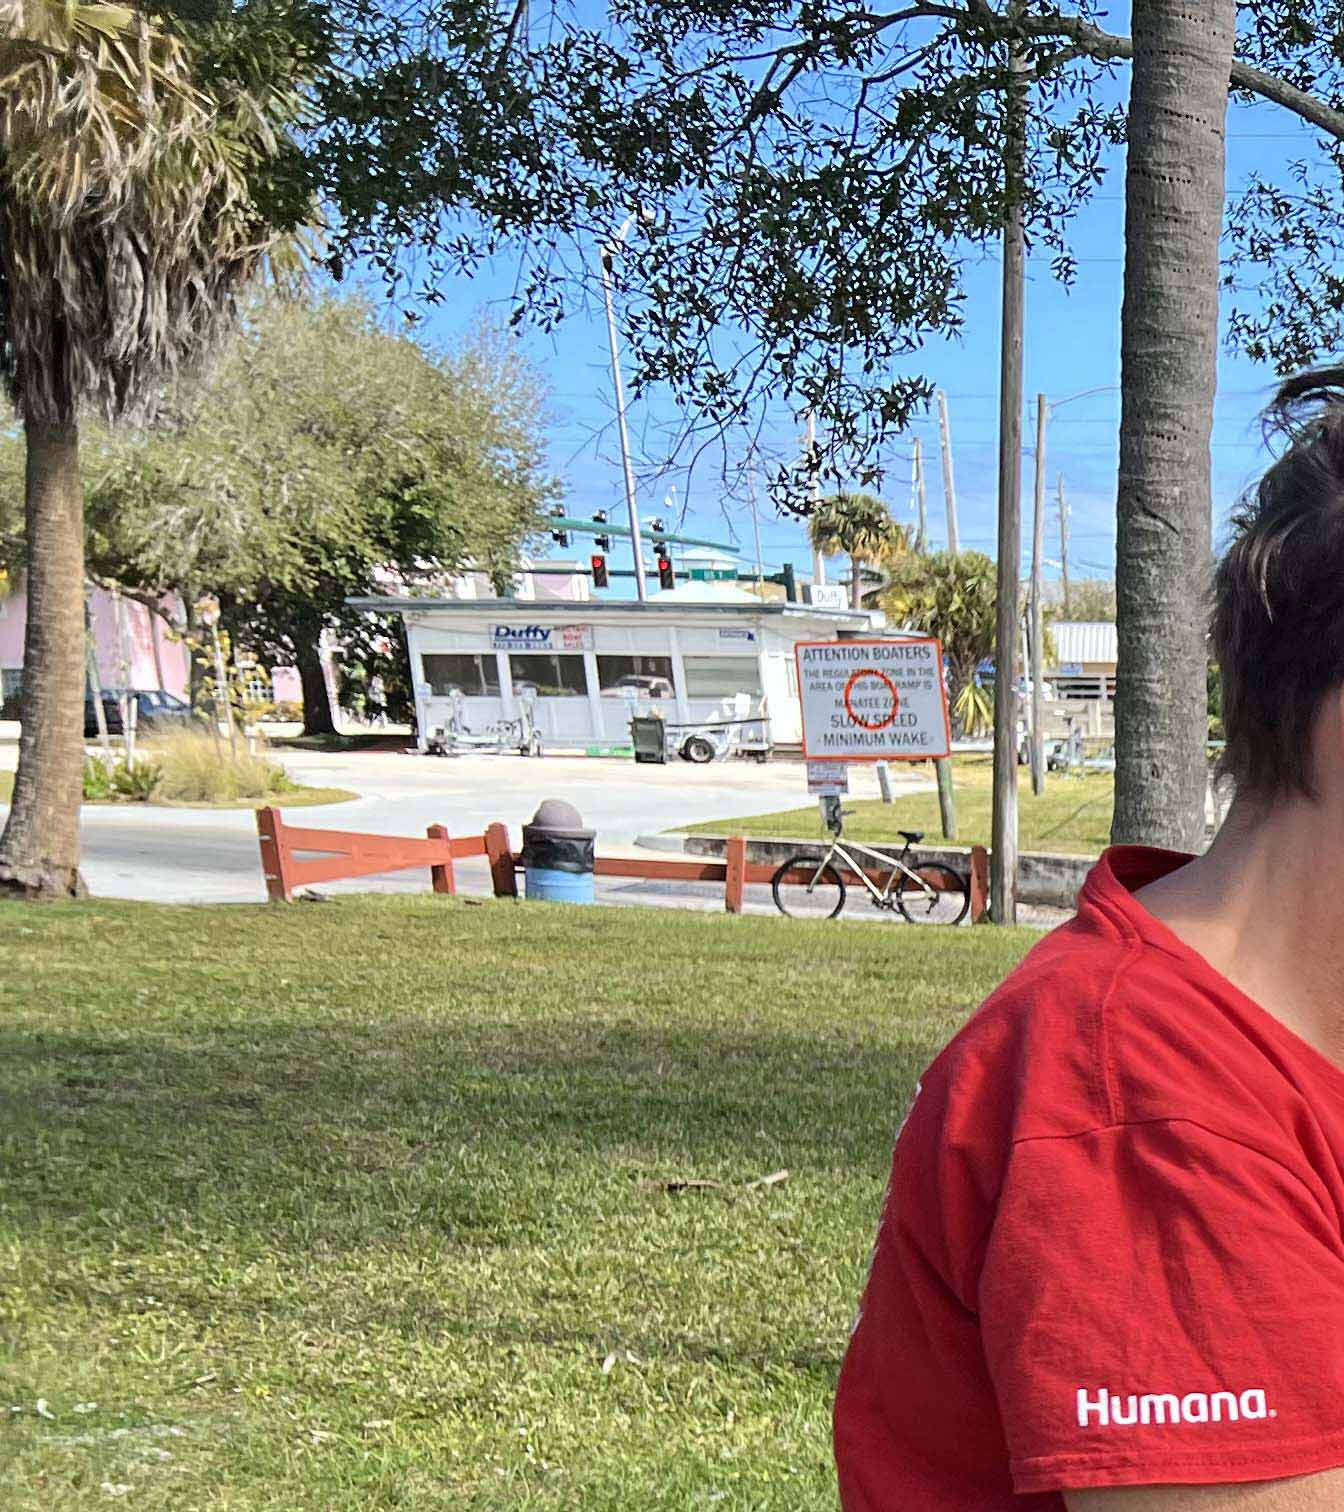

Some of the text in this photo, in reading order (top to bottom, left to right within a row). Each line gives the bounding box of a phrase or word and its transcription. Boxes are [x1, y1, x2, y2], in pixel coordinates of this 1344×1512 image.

[495, 625, 551, 641] Duffy
[803, 646, 931, 661] ATTENTION BOATERS
[919, 667, 934, 677] THE
[809, 682, 833, 691] AREA
[831, 713, 918, 728] SLOW SPEED
[823, 731, 929, 747] MINIMUM WAKE
